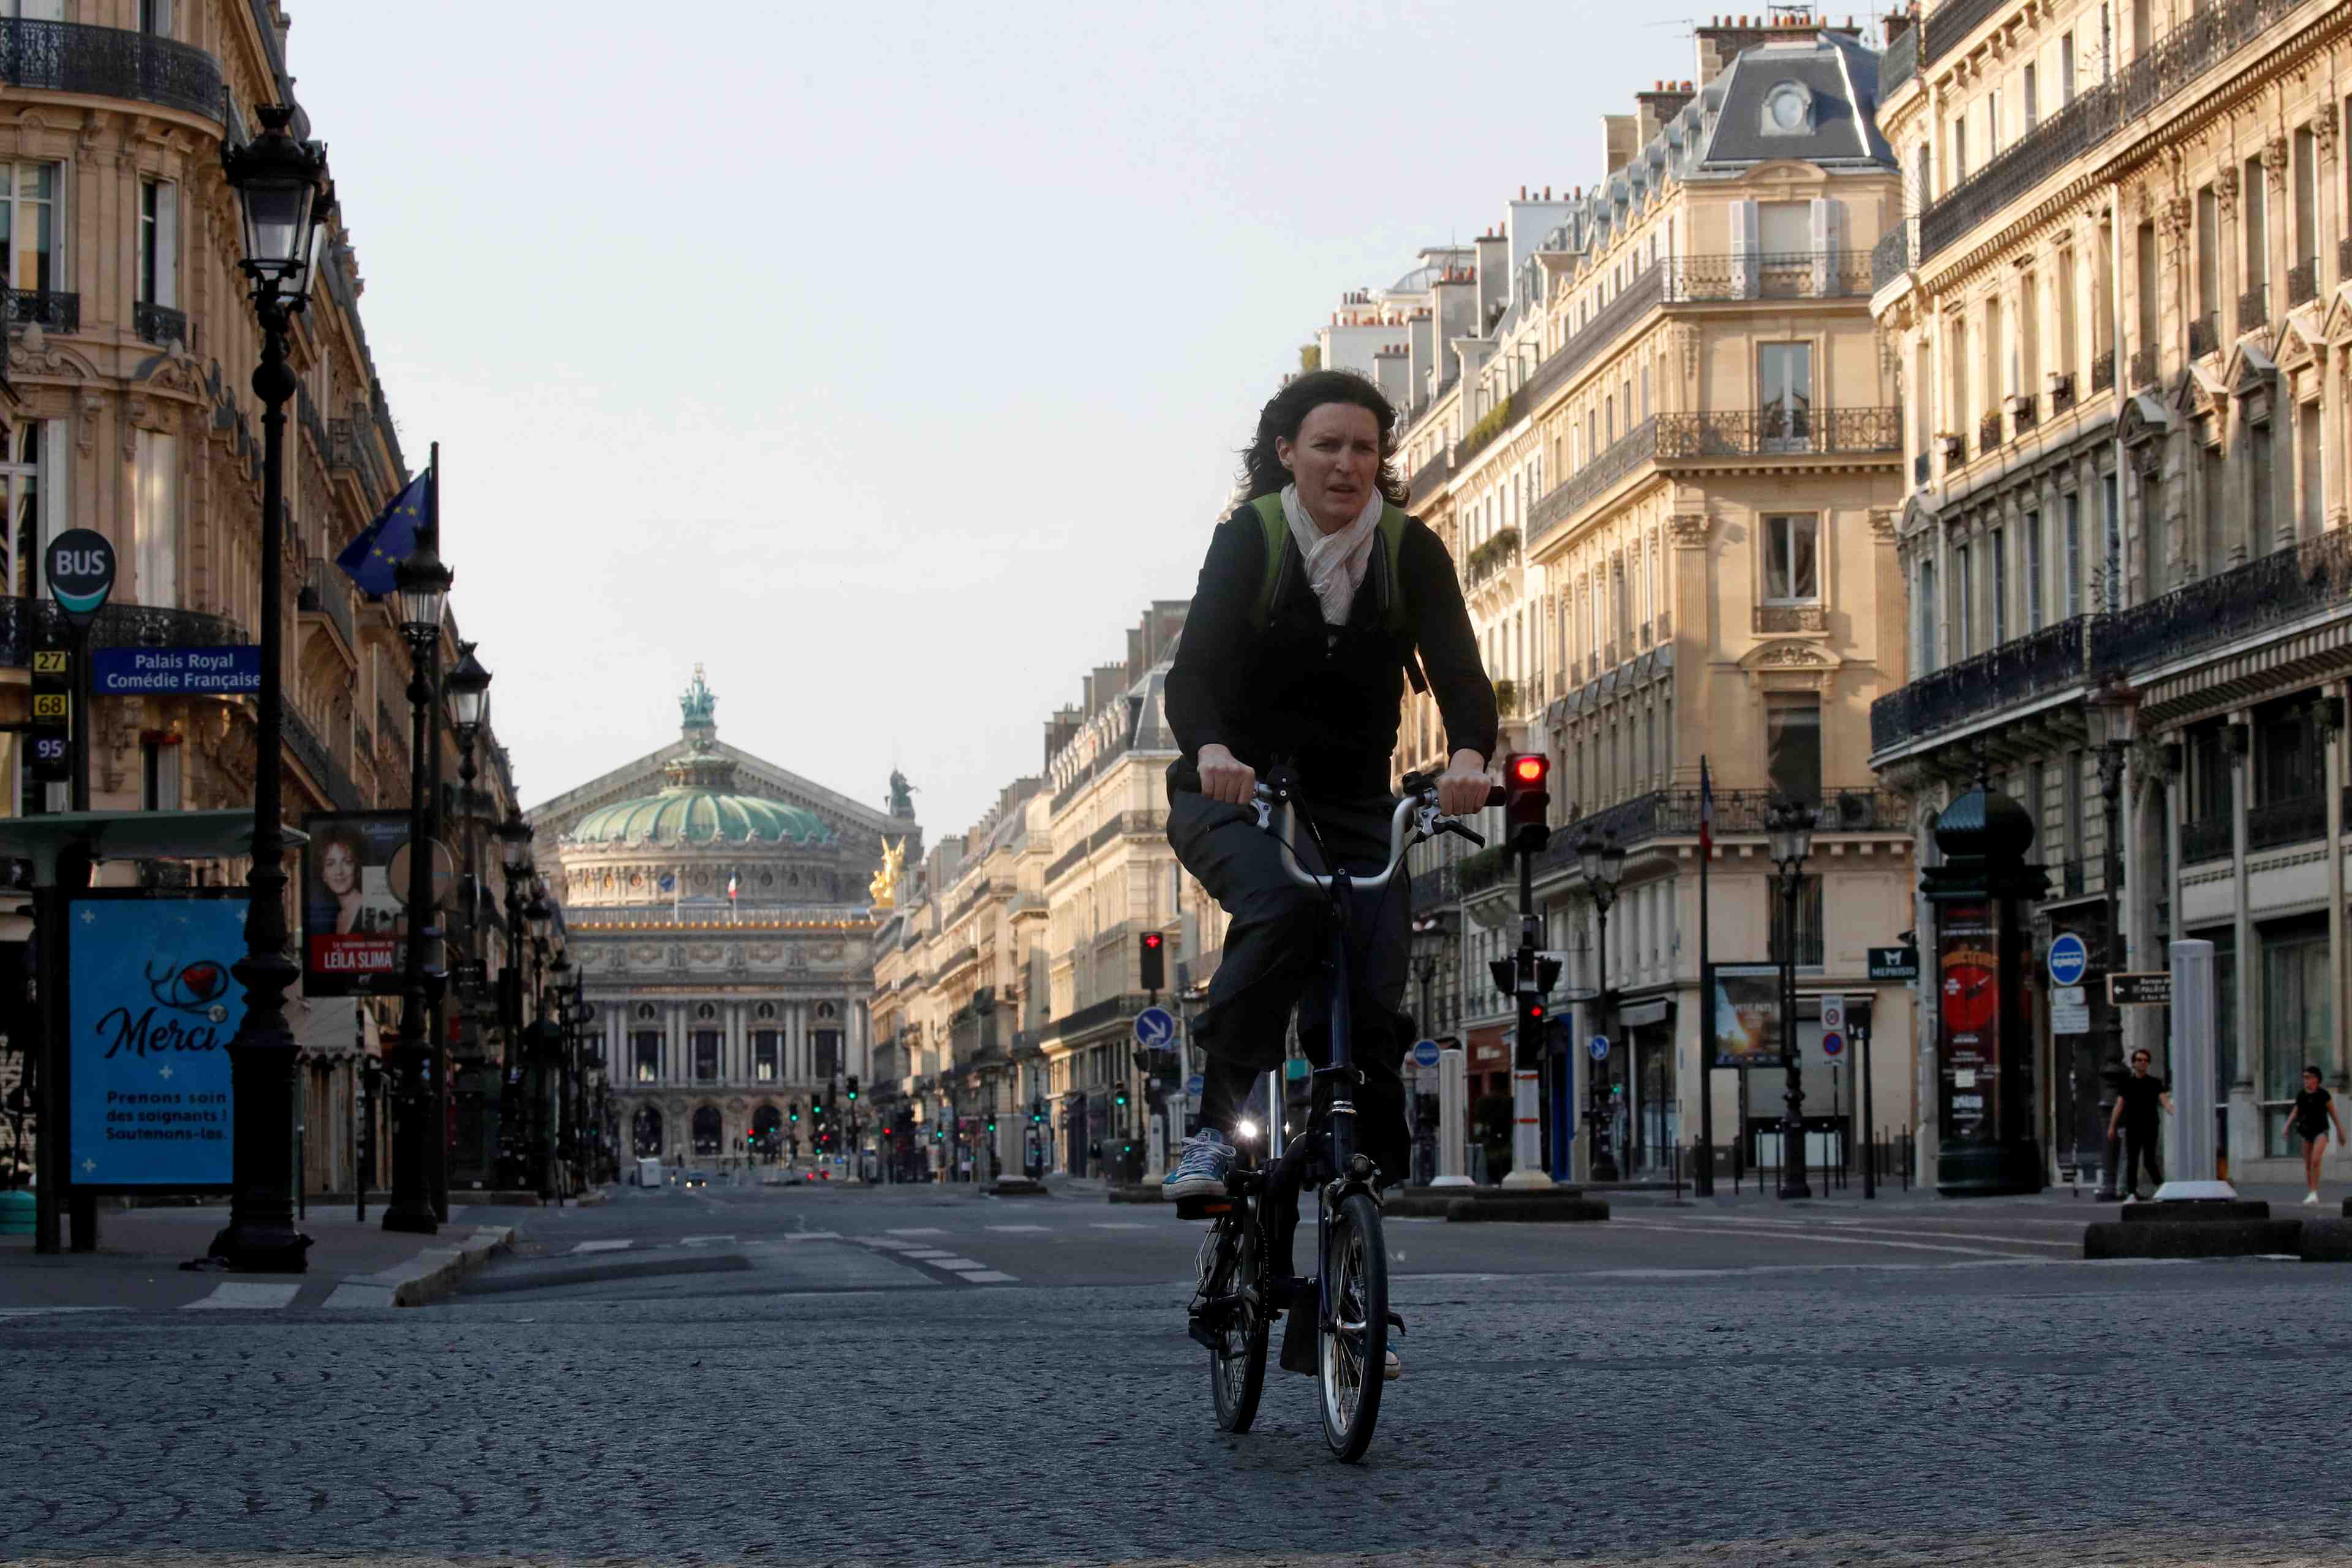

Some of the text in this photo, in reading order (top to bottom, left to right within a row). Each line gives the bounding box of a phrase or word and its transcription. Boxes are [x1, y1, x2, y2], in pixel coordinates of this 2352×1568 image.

[56, 550, 105, 575] BUS
[39, 654, 61, 669] 27
[135, 653, 233, 670] Palais Royal
[107, 673, 261, 690] Comédie Française
[39, 696, 61, 714] 68
[38, 739, 62, 758] 95
[357, 951, 393, 969] SLIMA
[96, 1006, 219, 1058] Merci
[107, 1090, 227, 1104] Prenons soin
[106, 1109, 134, 1123] des
[137, 1109, 217, 1125] soignants
[105, 1126, 228, 1140] Soutenons-les.
